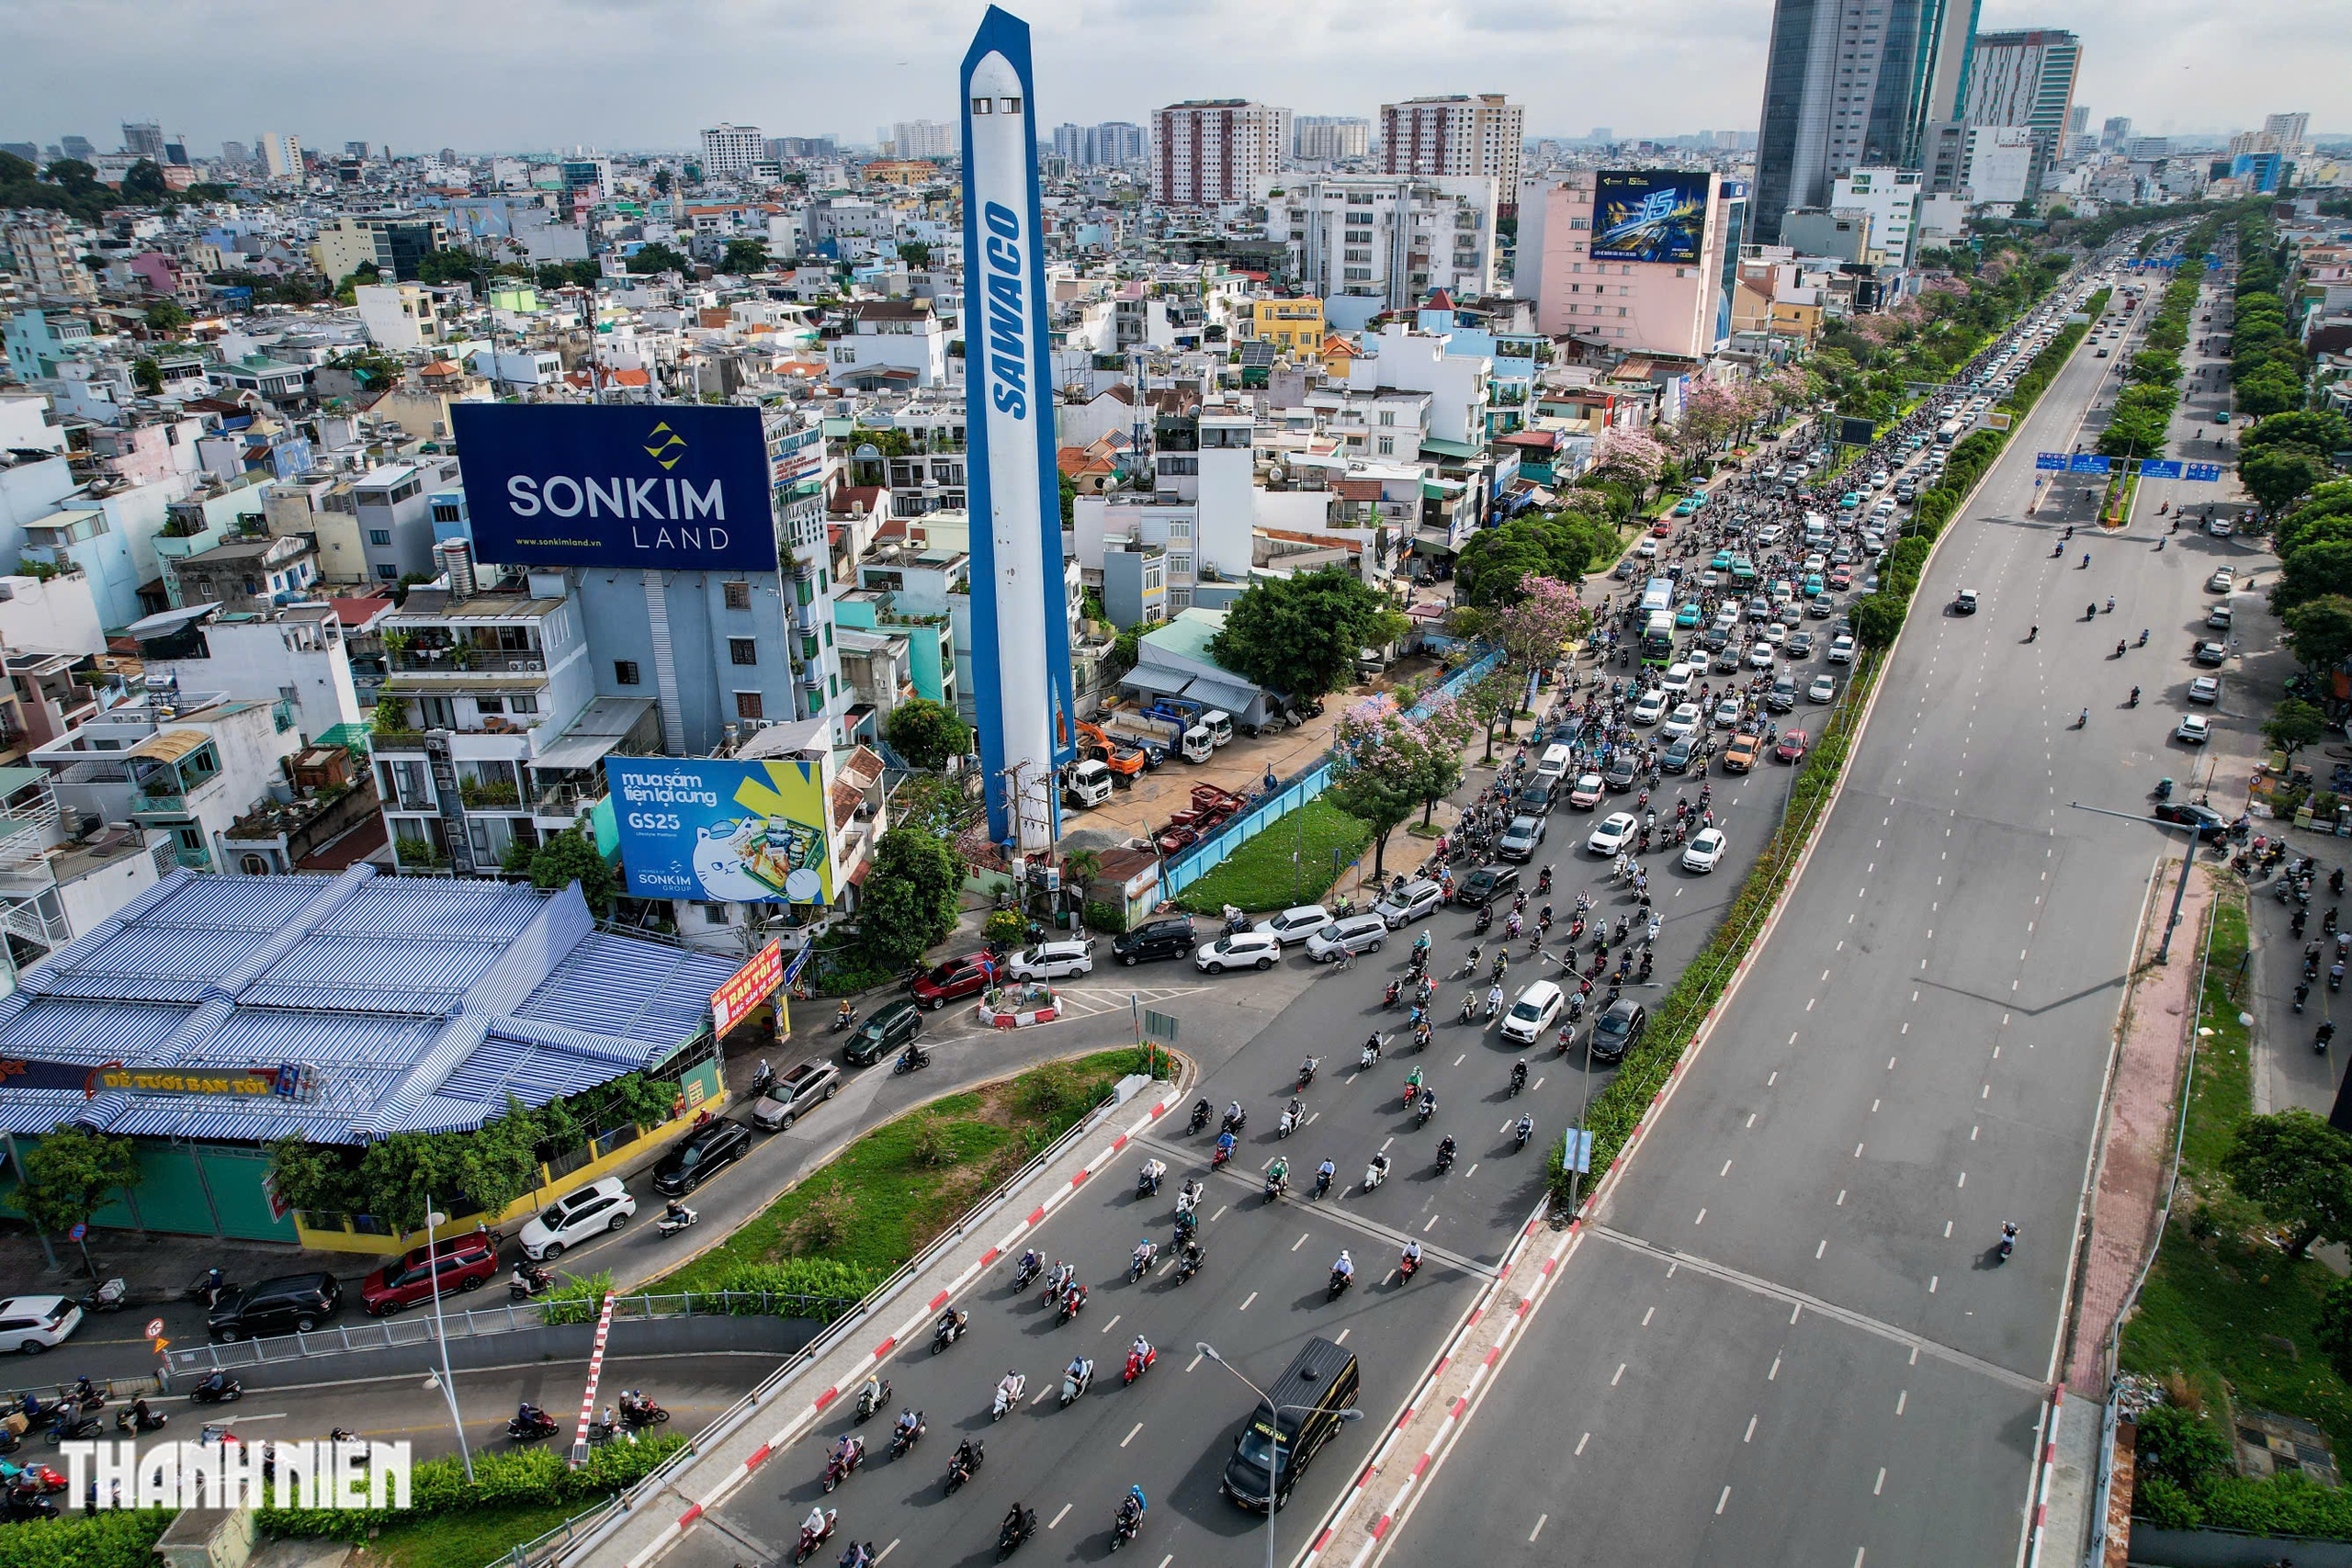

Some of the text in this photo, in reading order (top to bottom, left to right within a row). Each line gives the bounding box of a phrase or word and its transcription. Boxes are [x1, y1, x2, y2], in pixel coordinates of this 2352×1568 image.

[985, 200, 1025, 420] SAWACO
[801, 429, 820, 446] LINH
[507, 475, 725, 521] SONKIM
[515, 537, 602, 547] www.sonkimland.vn
[633, 526, 729, 550] LAND
[621, 767, 703, 788] mua sắm
[624, 784, 718, 807] tiện lợi cùng
[628, 812, 681, 830] GS25
[639, 874, 691, 886] SONKIM
[729, 979, 752, 1008] BẠN
[752, 960, 771, 986] TÔI
[103, 1072, 133, 1088] DÊ
[231, 1077, 267, 1095] TÔI
